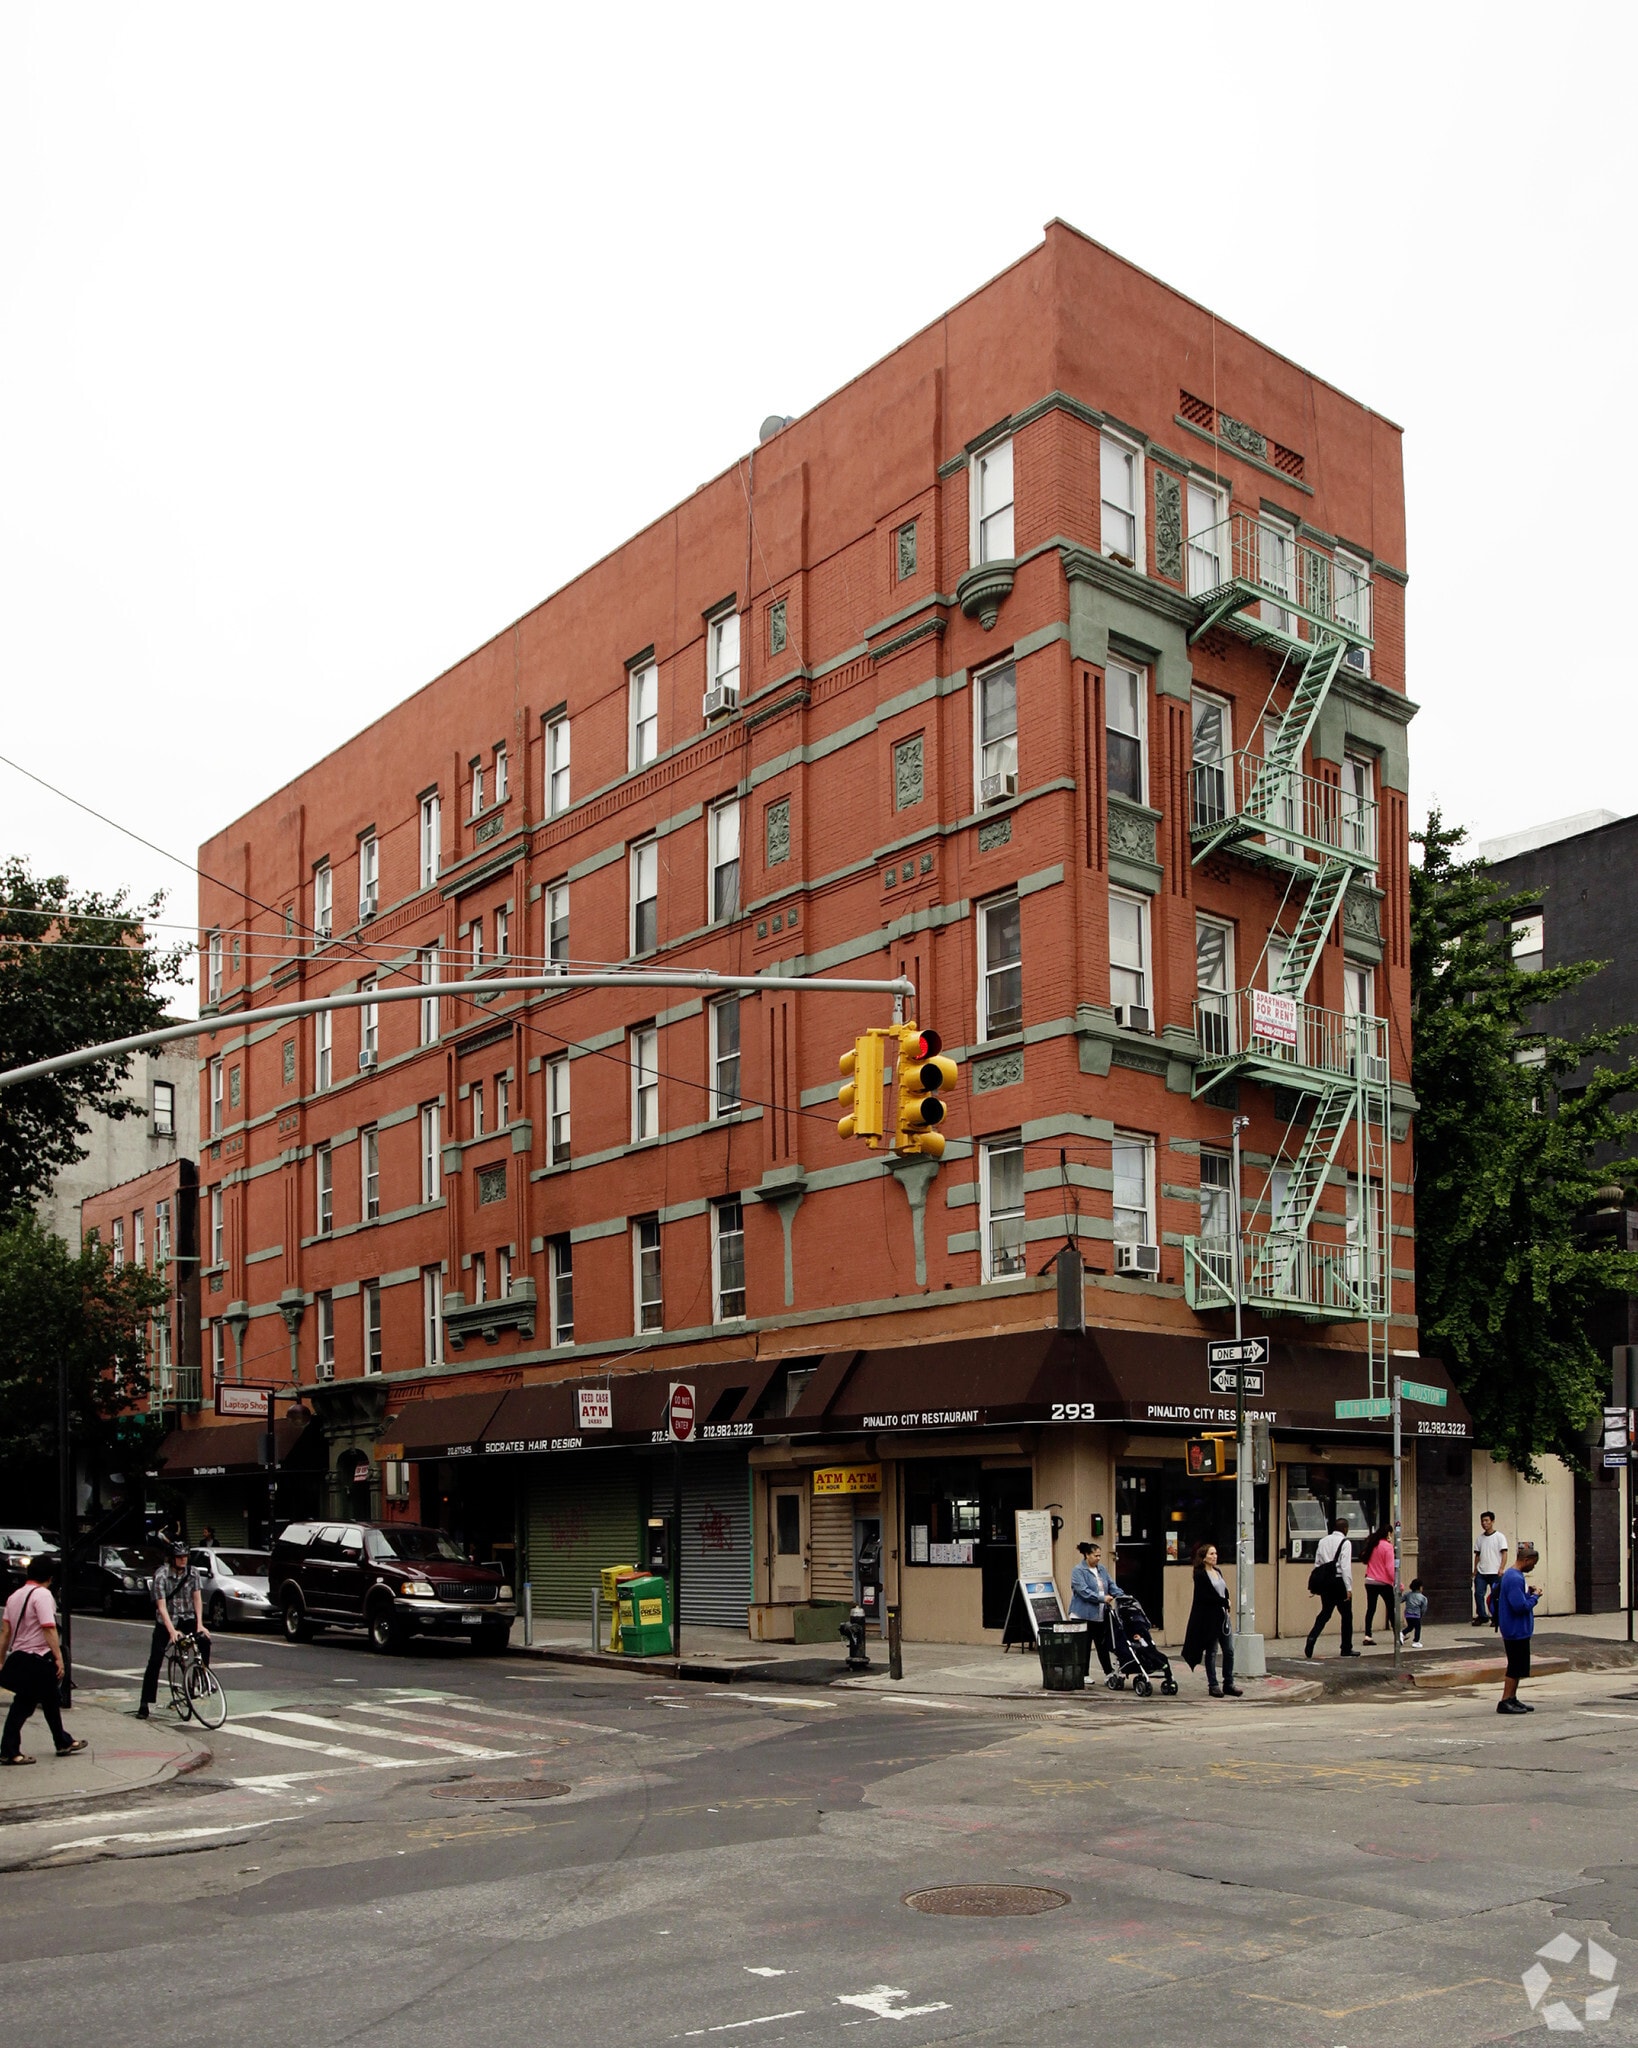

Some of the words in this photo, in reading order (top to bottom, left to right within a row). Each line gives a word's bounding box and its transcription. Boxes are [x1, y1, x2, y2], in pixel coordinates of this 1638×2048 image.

[1256, 993, 1294, 1012] APARTMENTS
[1256, 1003, 1272, 1016] FOR
[1274, 1008, 1294, 1023] RENT
[1217, 1348, 1235, 1359] ONE
[1218, 1375, 1234, 1386] ONE
[581, 1393, 594, 1403] NEED
[596, 1393, 609, 1403] CASH
[1409, 1383, 1440, 1403] HOUSTON
[224, 1400, 249, 1410] Laptop
[250, 1401, 268, 1411] Shop
[674, 1395, 681, 1405] DO
[681, 1396, 690, 1406] NOT
[582, 1405, 609, 1417] ATM
[1051, 1403, 1095, 1420] 293
[1147, 1405, 1191, 1419] PINALITO
[1193, 1407, 1215, 1420] CITY
[1337, 1401, 1381, 1417] CLINTON
[675, 1419, 689, 1430] ENTER
[863, 1414, 899, 1428] PINALITO
[901, 1413, 920, 1426] CITY
[921, 1410, 979, 1424] RESTAURANT
[703, 1422, 753, 1438] 212.982.3222
[1417, 1421, 1466, 1435] 212.982.3222
[485, 1441, 525, 1453] SOCRATES
[528, 1439, 548, 1451] HAIR
[551, 1437, 583, 1449] DESIGN
[816, 1473, 843, 1484] ATM
[847, 1472, 877, 1483] ATM
